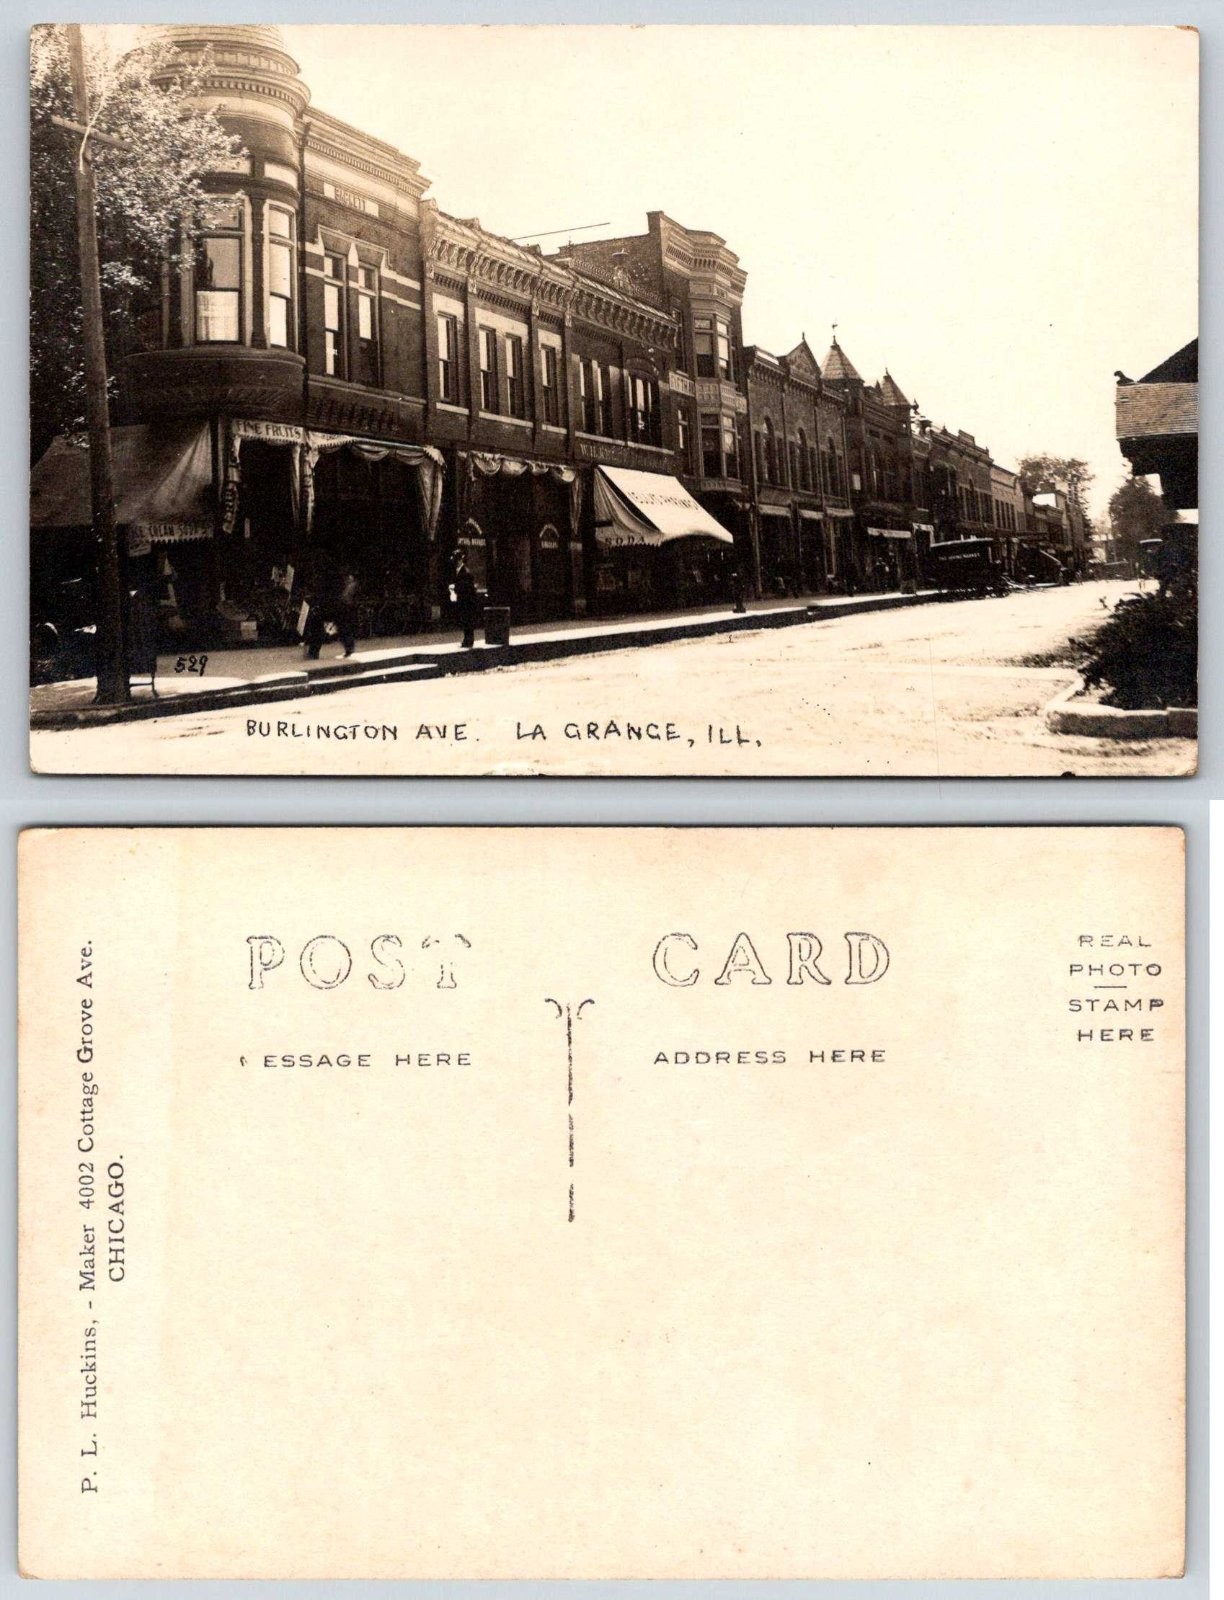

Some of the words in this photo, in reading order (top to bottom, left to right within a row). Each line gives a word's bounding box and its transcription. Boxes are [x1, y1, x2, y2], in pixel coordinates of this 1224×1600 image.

[236, 421, 262, 435] FINE
[265, 424, 301, 439] FRUITS
[605, 534, 645, 546] SODA
[1078, 934, 1152, 947] REAL
[76, 940, 93, 989] Ave.
[246, 934, 472, 990] POST
[652, 932, 890, 987] CARD
[1069, 963, 1162, 976] PHOTO
[1068, 998, 1165, 1012] STAMP
[76, 998, 94, 1063] Grove
[1078, 1028, 1155, 1042] HERE
[239, 1054, 372, 1068] ESSAGE
[395, 1053, 472, 1067] HERE
[653, 1051, 787, 1065] ADDRESS
[809, 1050, 886, 1063] HERE
[77, 1071, 99, 1153] Cottage
[78, 1162, 95, 1209] 4002
[107, 1154, 125, 1283] CHICAGO.
[79, 1224, 96, 1291] Maker
[81, 1318, 99, 1419] Huckins,
[81, 1432, 98, 1457] L.
[81, 1472, 98, 1494] P.
